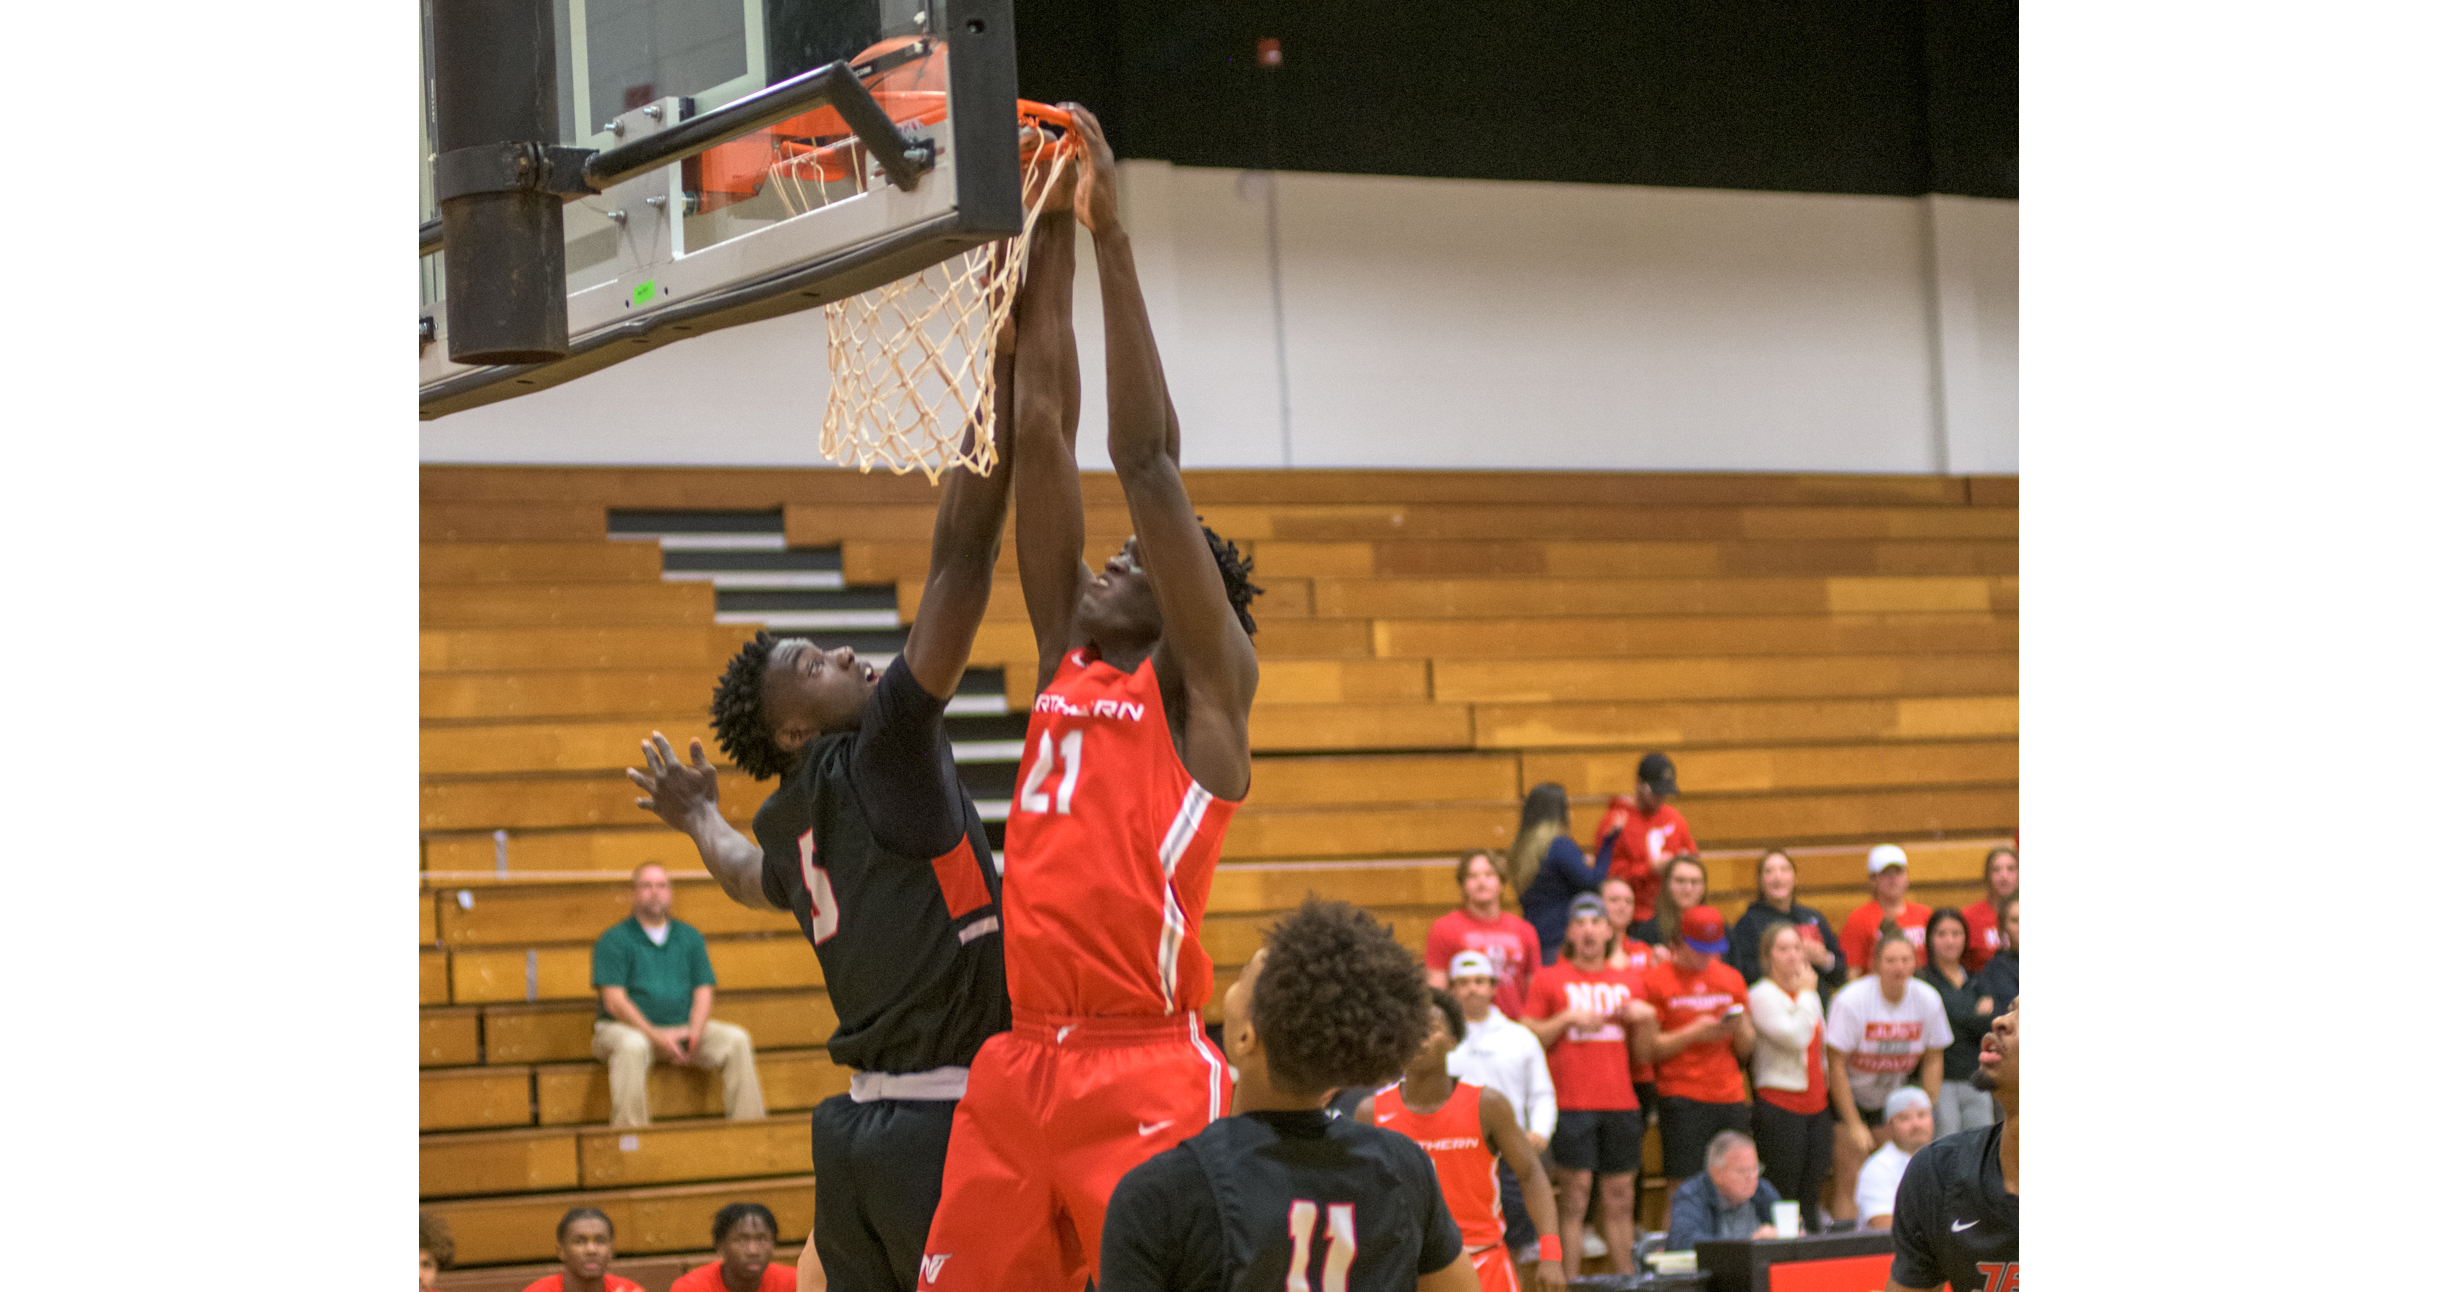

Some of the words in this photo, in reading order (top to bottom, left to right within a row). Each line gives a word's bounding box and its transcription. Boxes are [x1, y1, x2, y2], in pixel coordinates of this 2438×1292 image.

[1020, 728, 1083, 815] 21
[797, 826, 839, 946] 5
[1285, 1198, 1358, 1292] 11
